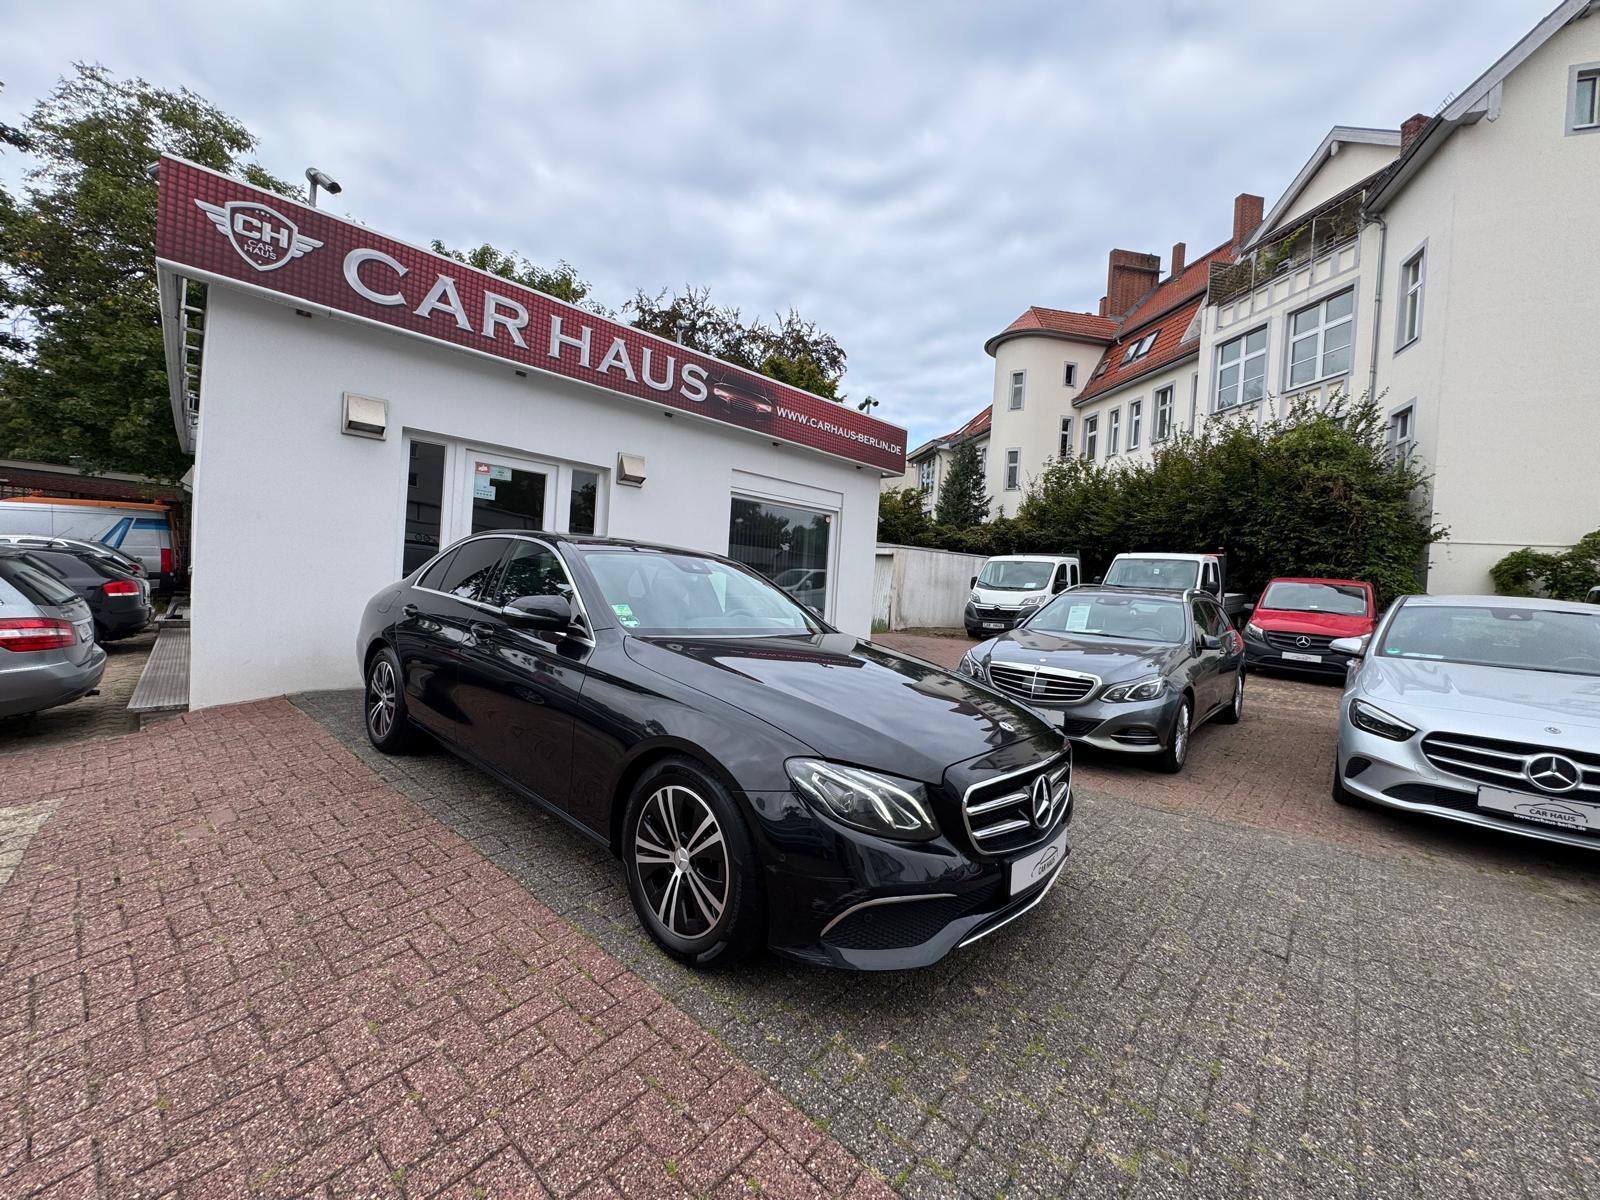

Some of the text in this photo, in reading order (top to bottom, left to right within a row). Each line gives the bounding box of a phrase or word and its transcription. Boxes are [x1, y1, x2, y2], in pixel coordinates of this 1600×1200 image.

[234, 213, 289, 249] CH
[244, 244, 277, 260] HAUS
[248, 239, 273, 253] CAR
[343, 248, 709, 402] CAR HAUS
[776, 406, 902, 456] WWW.CARHAUS-BERLIN.DE
[1529, 809, 1576, 822] CAR HAUS
